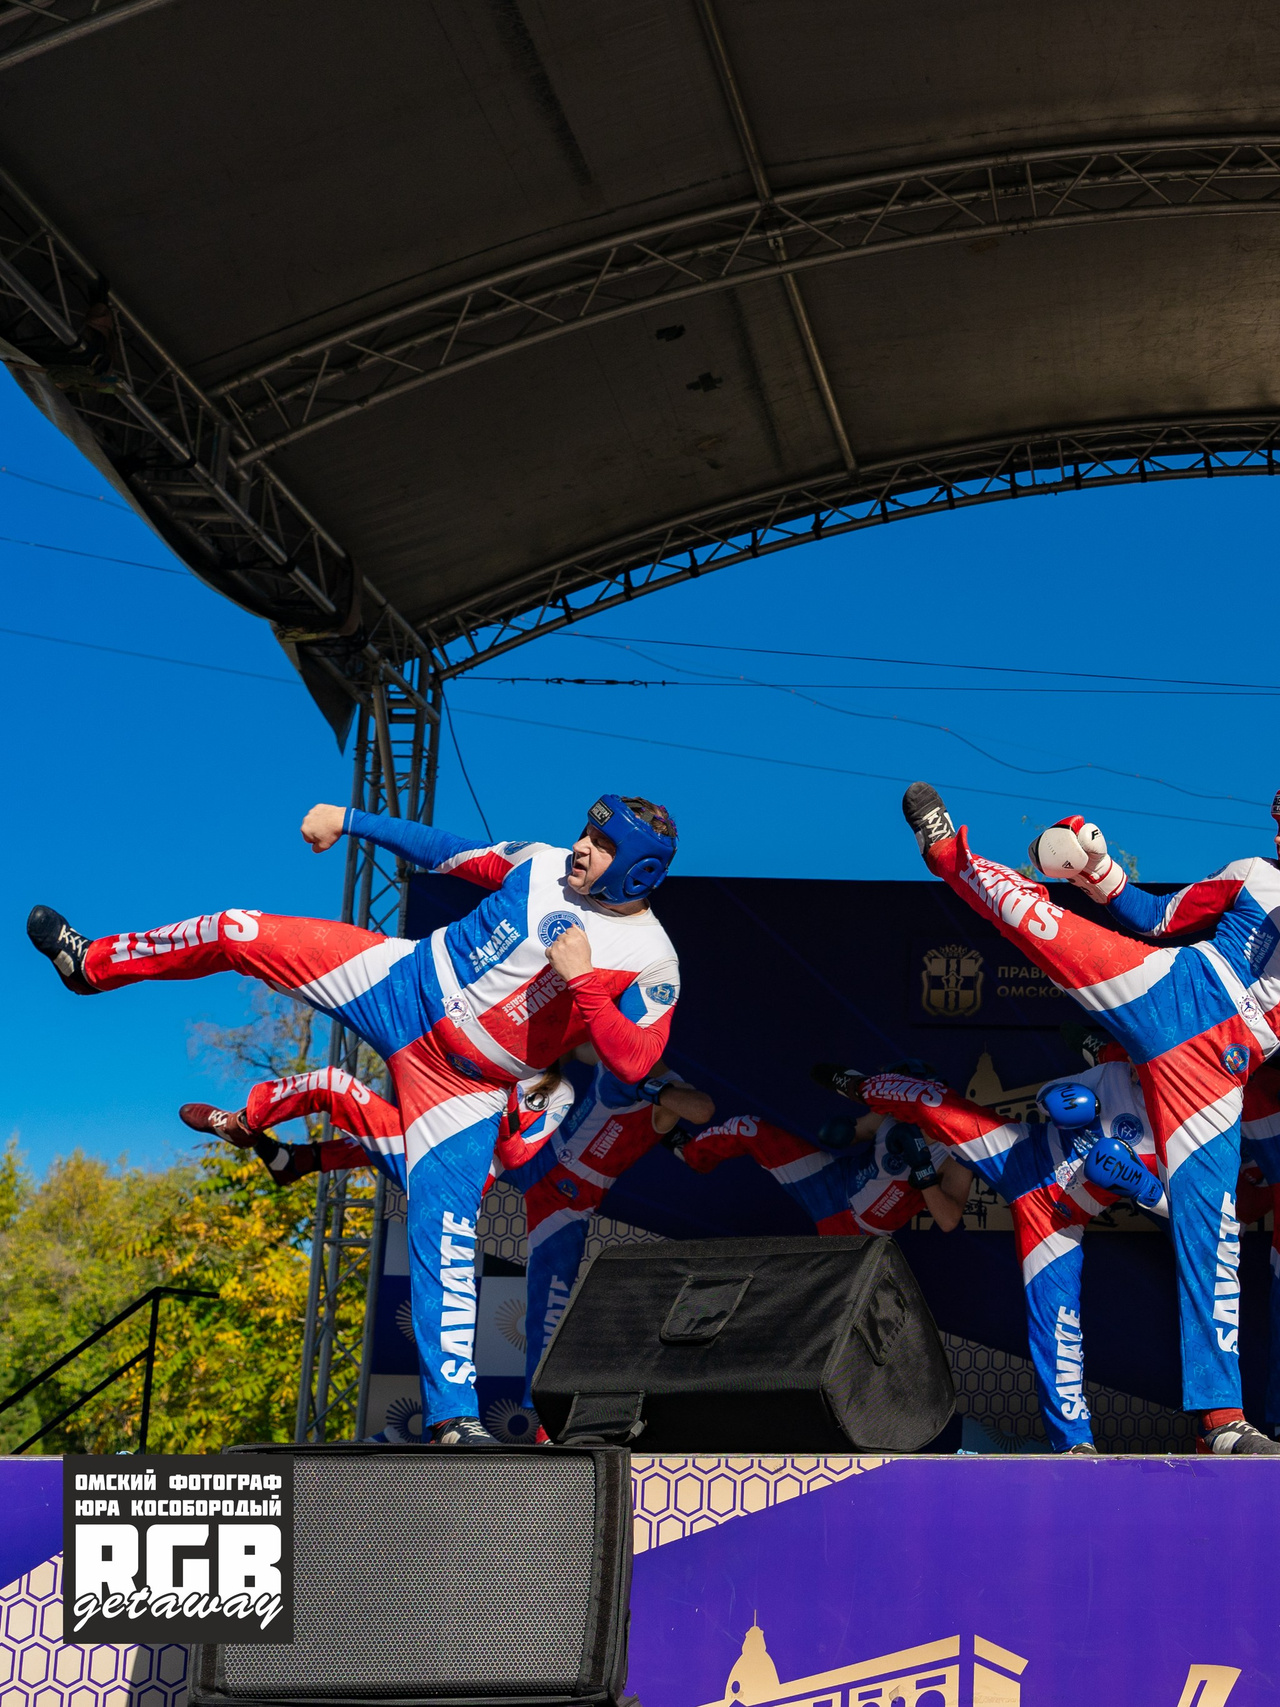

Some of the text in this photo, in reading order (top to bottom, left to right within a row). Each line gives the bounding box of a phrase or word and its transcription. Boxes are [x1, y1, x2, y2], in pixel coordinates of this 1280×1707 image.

[110, 909, 262, 963] SAVATE
[469, 919, 516, 966] SAVATE
[507, 973, 567, 1027] SAVATE
[996, 985, 1067, 998] ОМСКО
[270, 1066, 371, 1105] SAVATE
[594, 1122, 624, 1160] SAVATE
[1095, 1150, 1143, 1186] VENUM
[875, 1188, 905, 1218] SAVATE
[1212, 1191, 1241, 1356] SAVATE
[440, 1211, 477, 1389] SAVATE
[1054, 1305, 1085, 1421] SAVATE
